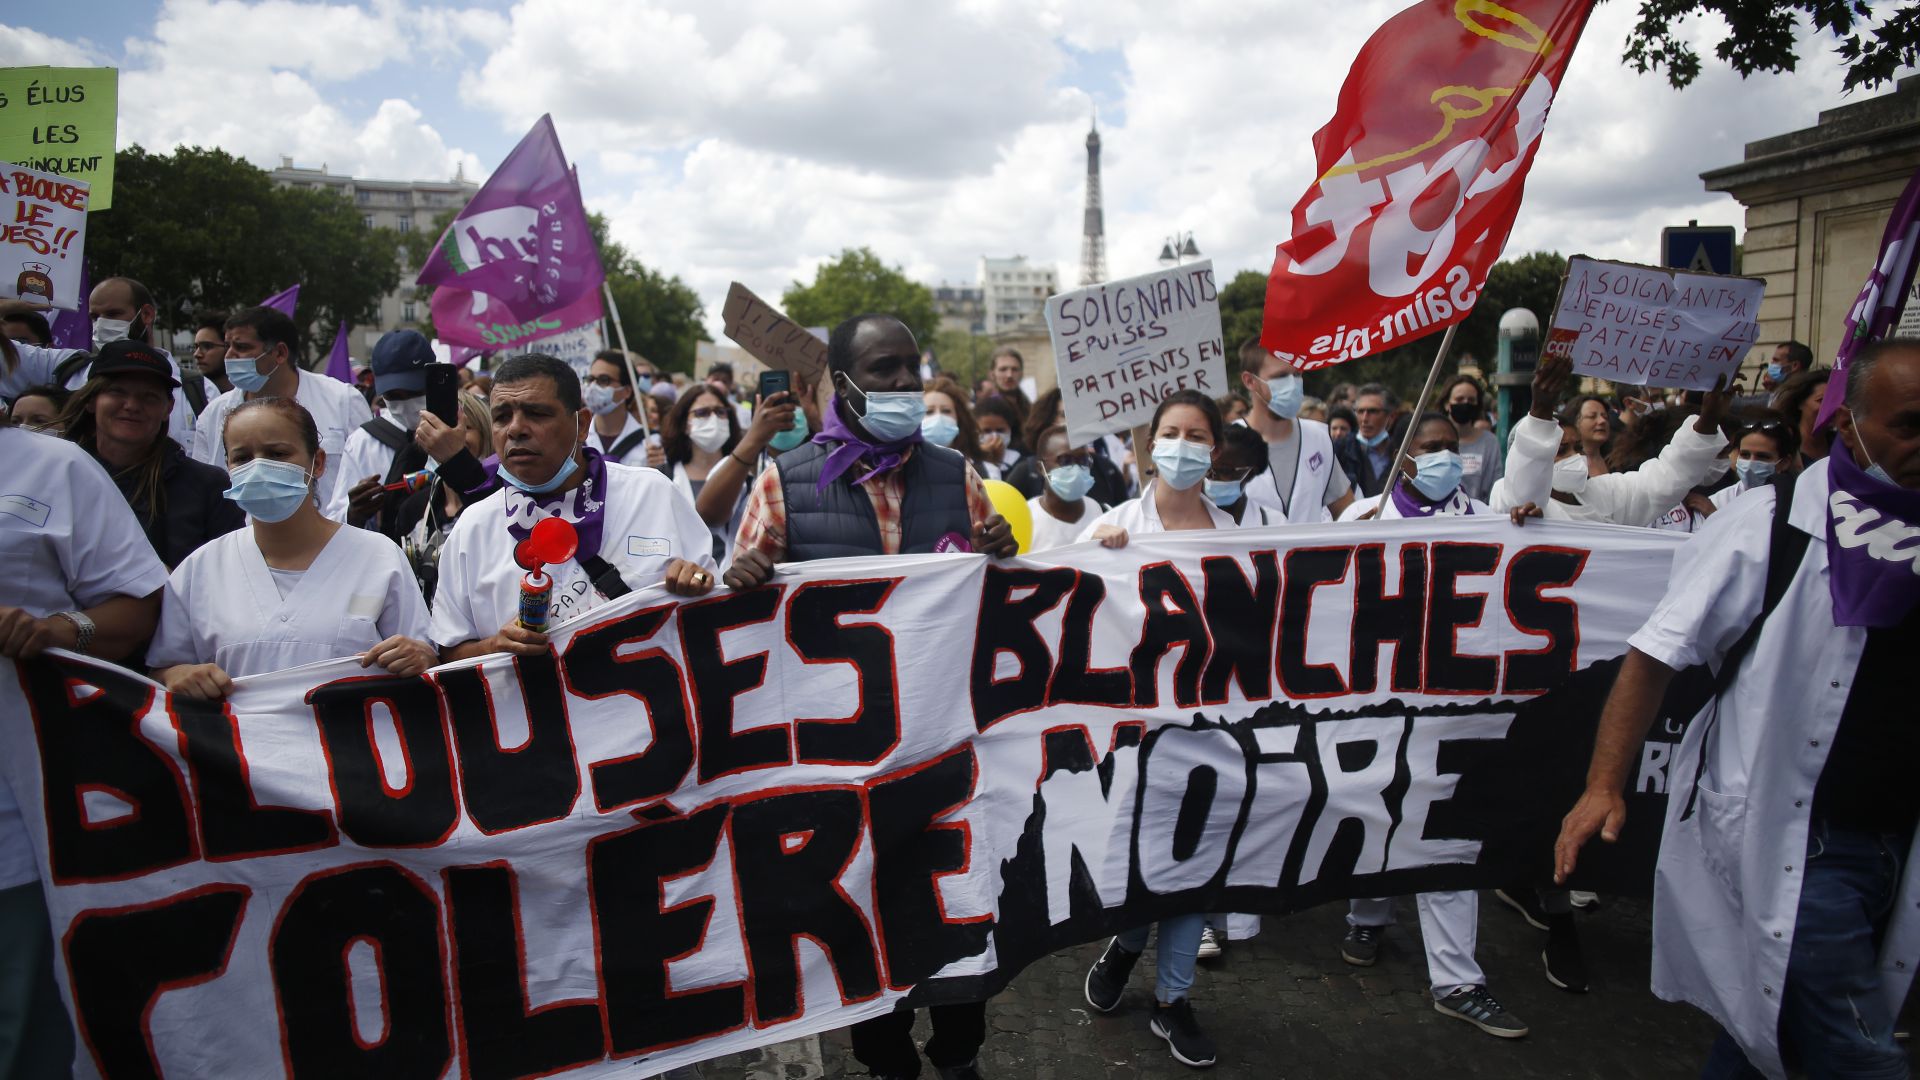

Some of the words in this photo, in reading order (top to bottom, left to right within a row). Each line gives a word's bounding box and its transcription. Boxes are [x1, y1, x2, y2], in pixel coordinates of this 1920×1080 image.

[27, 79, 86, 106] ÉLUS
[32, 124, 80, 145] LES
[10, 171, 90, 212] BLOUSE
[15, 200, 54, 228] LE
[1060, 268, 1219, 336] SOIGNANTS
[1591, 271, 1736, 309] SOIGNANTS
[1577, 322, 1704, 360] PATIENTS
[1707, 344, 1740, 363] EN
[1072, 346, 1190, 398] PATIENTS
[1198, 337, 1223, 363] EN
[1581, 350, 1702, 382] DANGER
[1095, 368, 1212, 420] DANGER
[16, 576, 907, 888] BLOUSES
[969, 541, 1591, 734] BLANCHES
[62, 742, 997, 1080] COLÈRE
[1035, 712, 1518, 927] NOIRE
